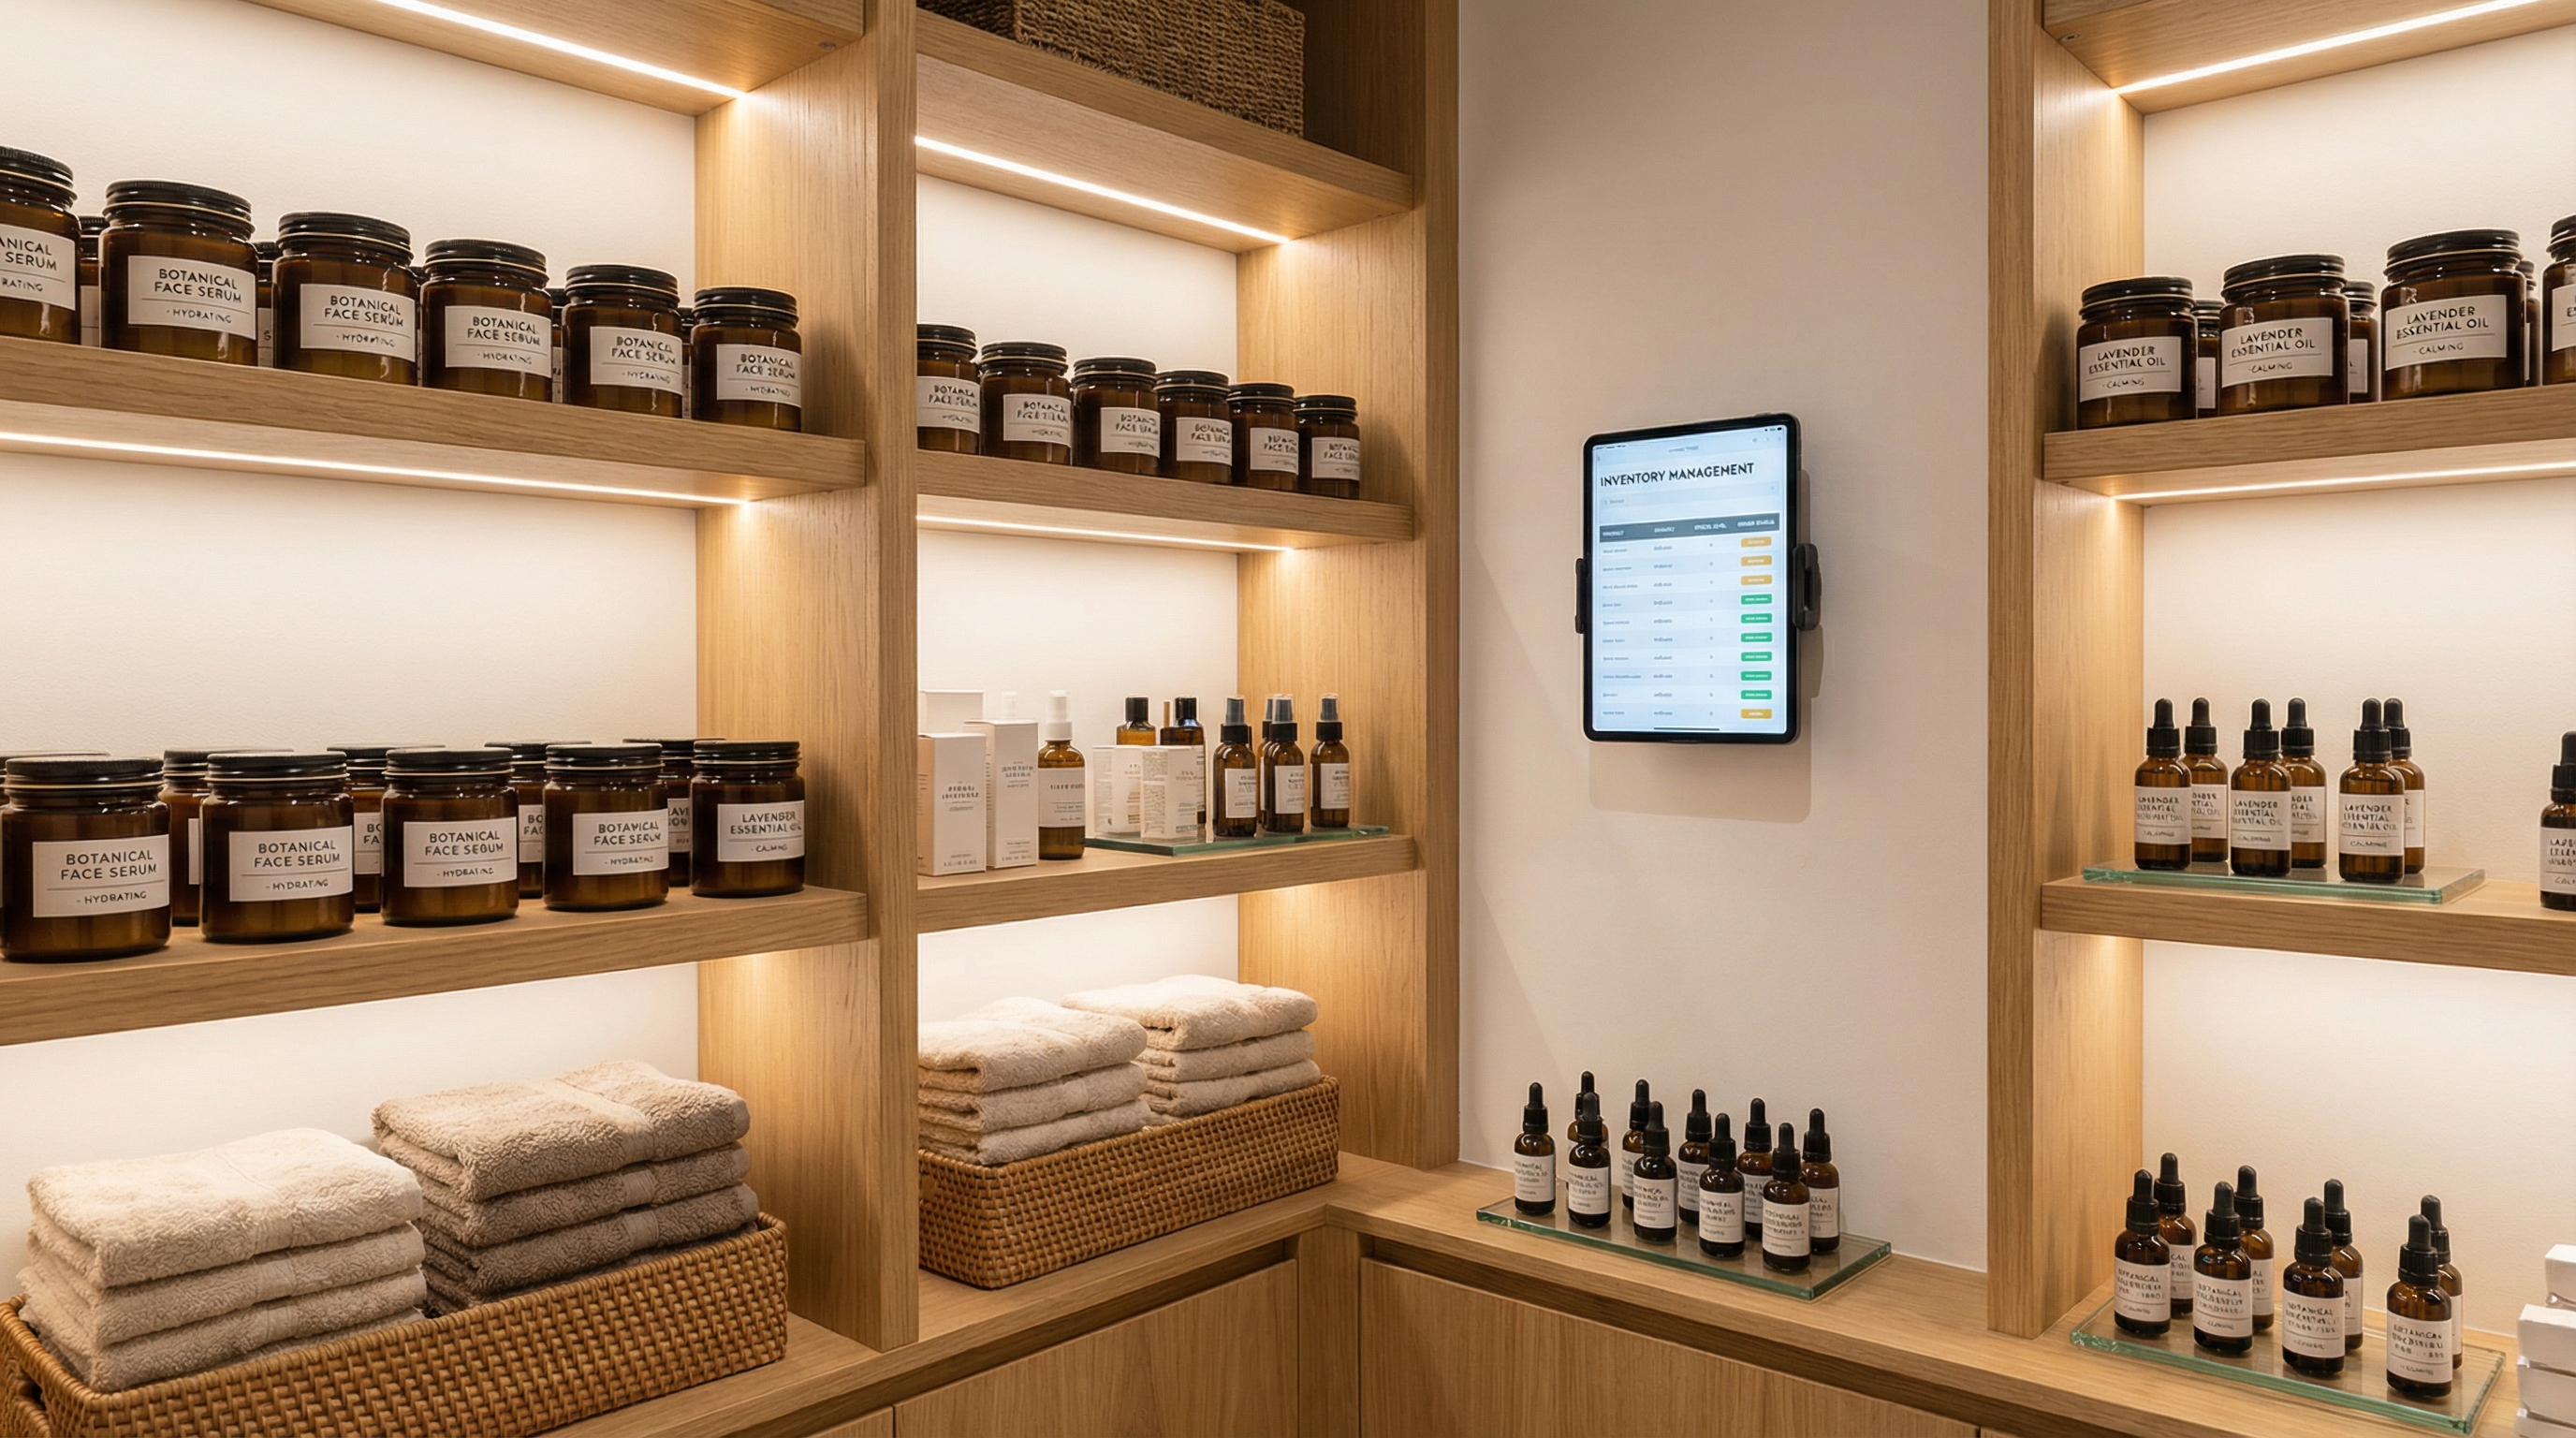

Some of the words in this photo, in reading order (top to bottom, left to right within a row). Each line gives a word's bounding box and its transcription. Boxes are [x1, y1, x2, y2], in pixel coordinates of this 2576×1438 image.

[5, 251, 57, 271] SERUM
[159, 268, 238, 290] BOTANICAL
[154, 281, 193, 296] FACE
[198, 286, 242, 303] SERUM
[330, 295, 402, 315] BOTANICAL
[324, 307, 359, 321] FACE
[2407, 305, 2476, 325] LAVENDER
[473, 316, 537, 335] BOTANICAL
[2396, 320, 2462, 340] ESSENTIAL
[2466, 317, 2489, 329] OIL
[467, 328, 500, 341] FACE
[2240, 328, 2303, 345] LAVENDER
[611, 347, 641, 360] FACE
[2097, 345, 2156, 361] LAVENDER
[2231, 340, 2291, 359] ESSENTIAL
[2294, 339, 2316, 349] OIL
[736, 363, 763, 374] FACE
[2088, 358, 2143, 374] ESSENTIAL
[2146, 357, 2166, 367] OIL
[1600, 470, 1665, 487] INVENTORY
[1668, 462, 1754, 480] MANAGEMENT
[741, 811, 796, 823] LAVENDER
[598, 820, 659, 834] BOTANICAL
[730, 824, 787, 835] ESSENTIAL
[429, 830, 501, 844] BOTANICAL
[593, 835, 625, 845] FACE
[258, 840, 336, 854] BOTANICAL
[425, 845, 460, 856] FACE
[66, 850, 154, 865] BOTANICAL
[254, 856, 292, 868] FACE
[298, 853, 341, 866] SERUM
[61, 868, 103, 880] FACE
[110, 863, 157, 878] SERUM
